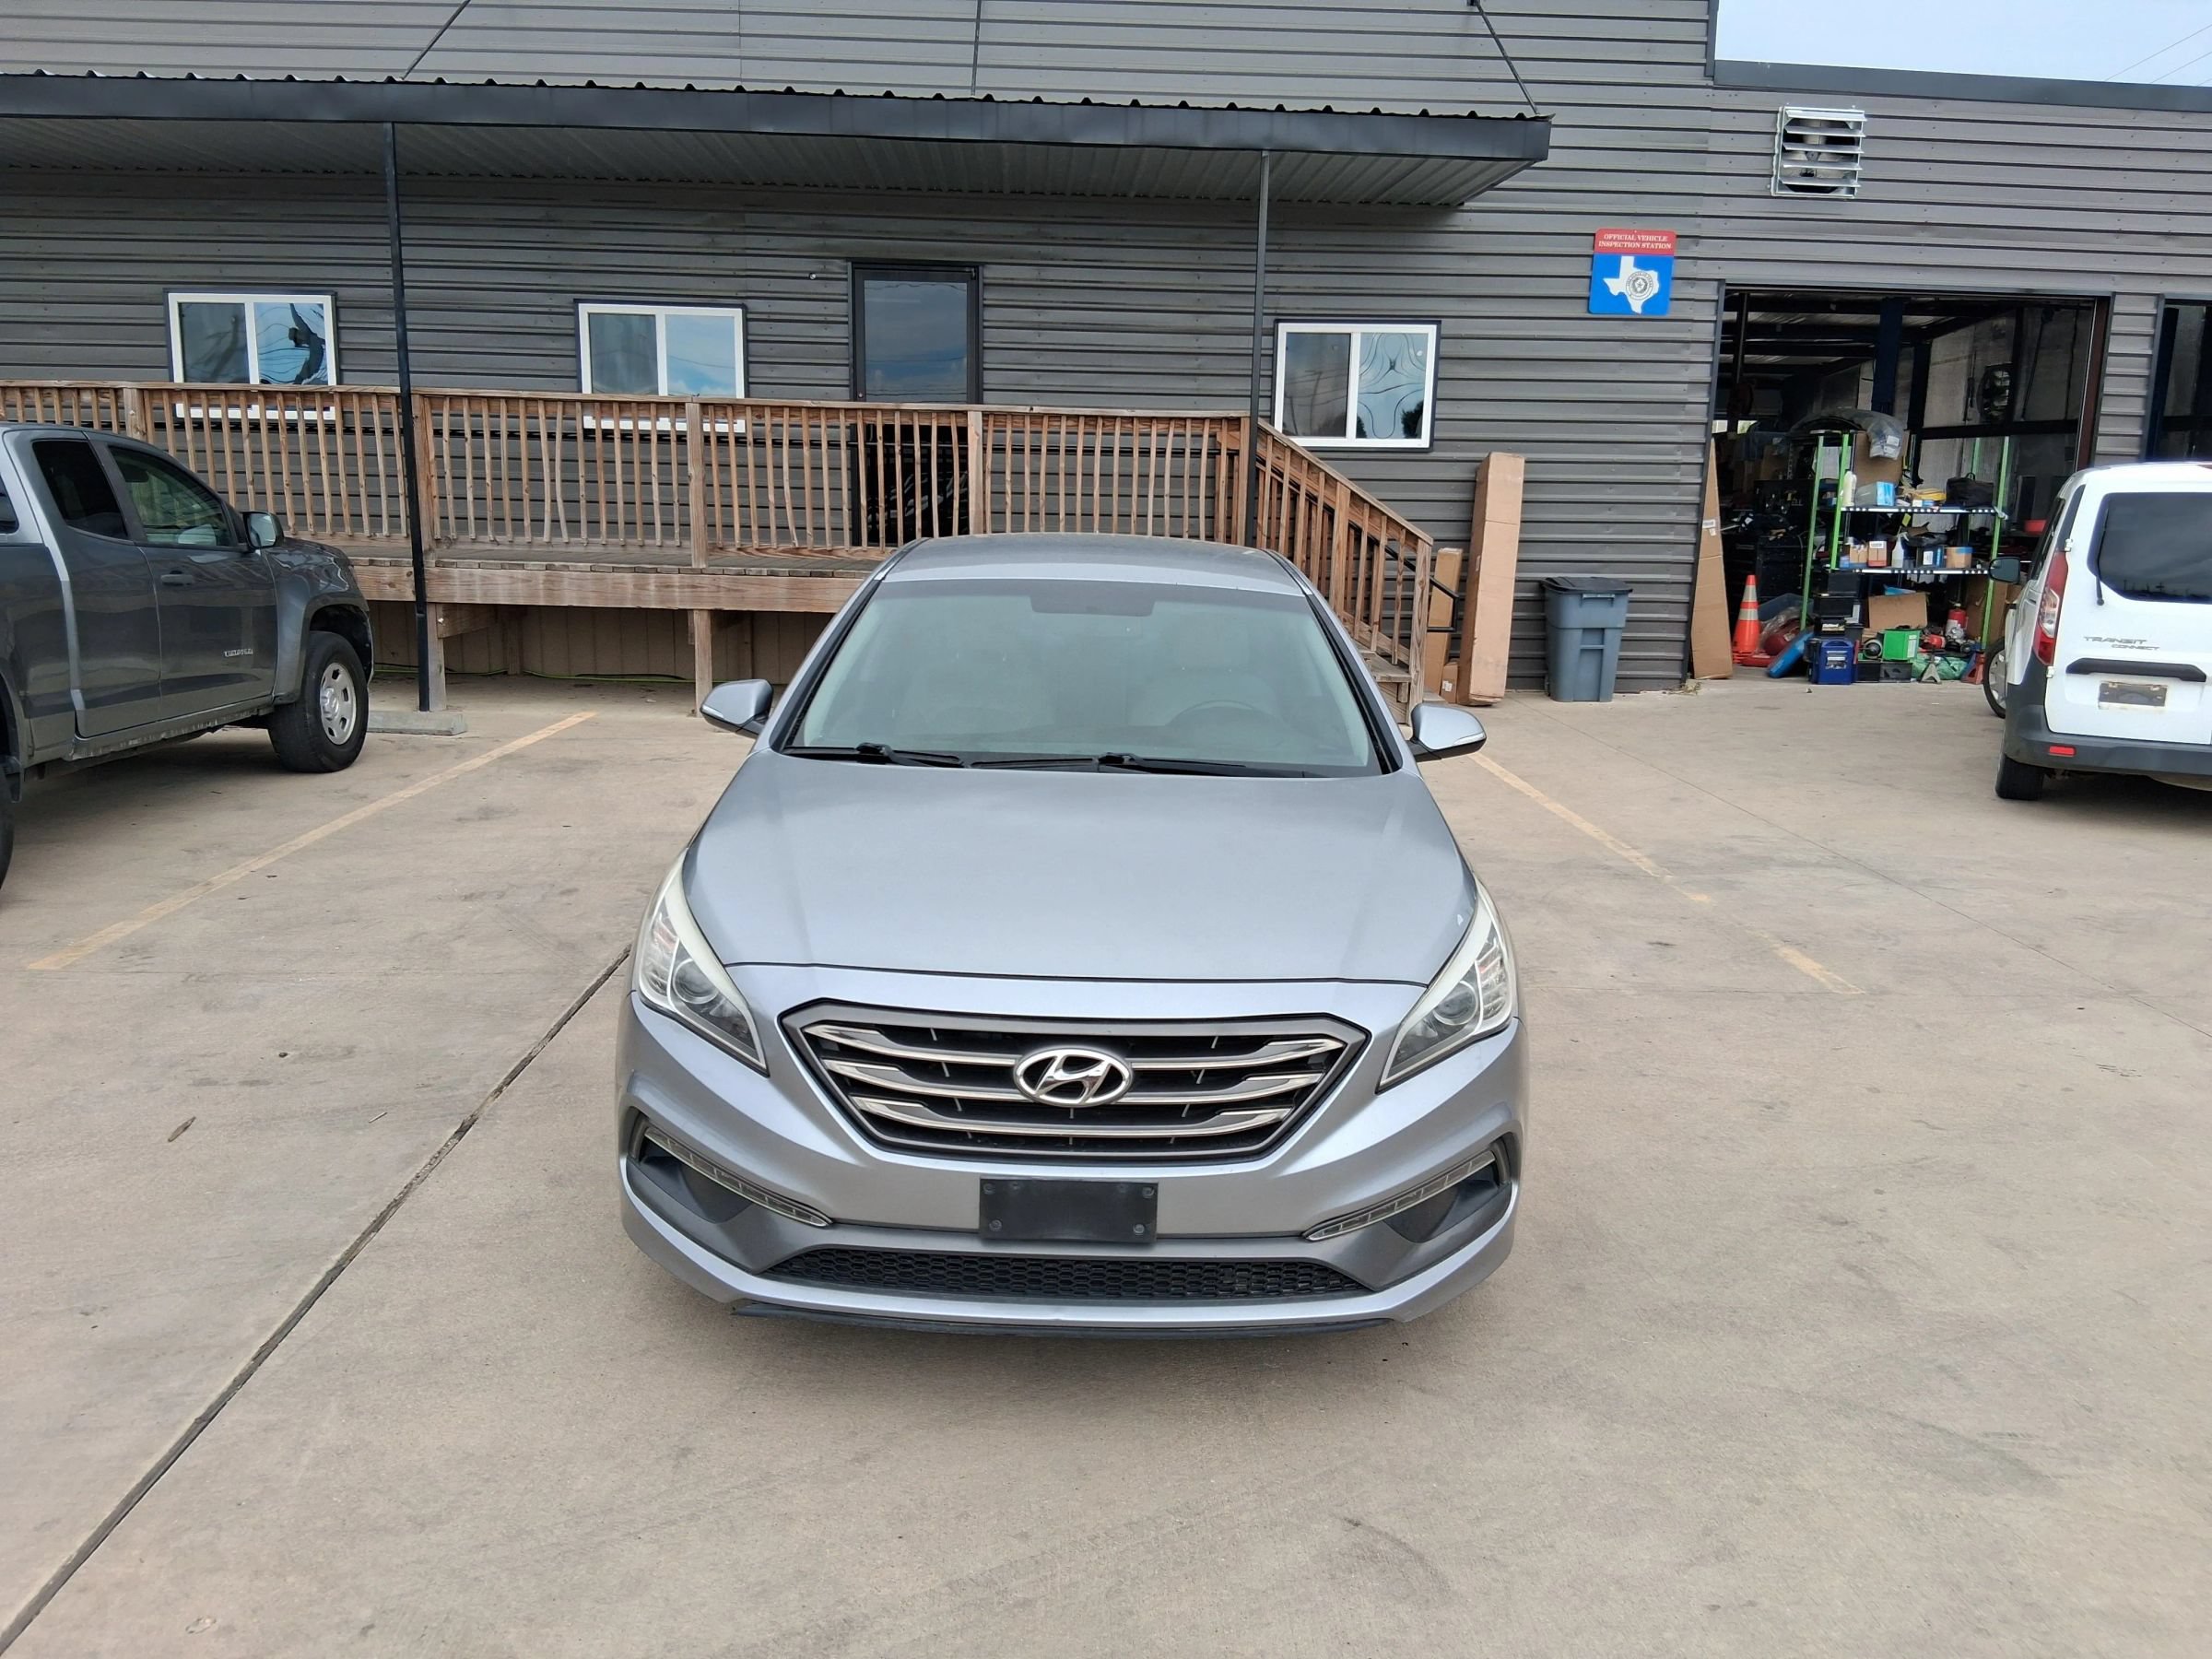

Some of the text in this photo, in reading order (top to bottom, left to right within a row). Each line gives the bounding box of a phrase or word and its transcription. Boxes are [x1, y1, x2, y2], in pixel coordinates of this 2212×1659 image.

[1637, 234, 1668, 242] VEHICLE
[1598, 241, 1672, 250] INSPECTION STATION
[2083, 636, 2147, 644] TRANSIT
